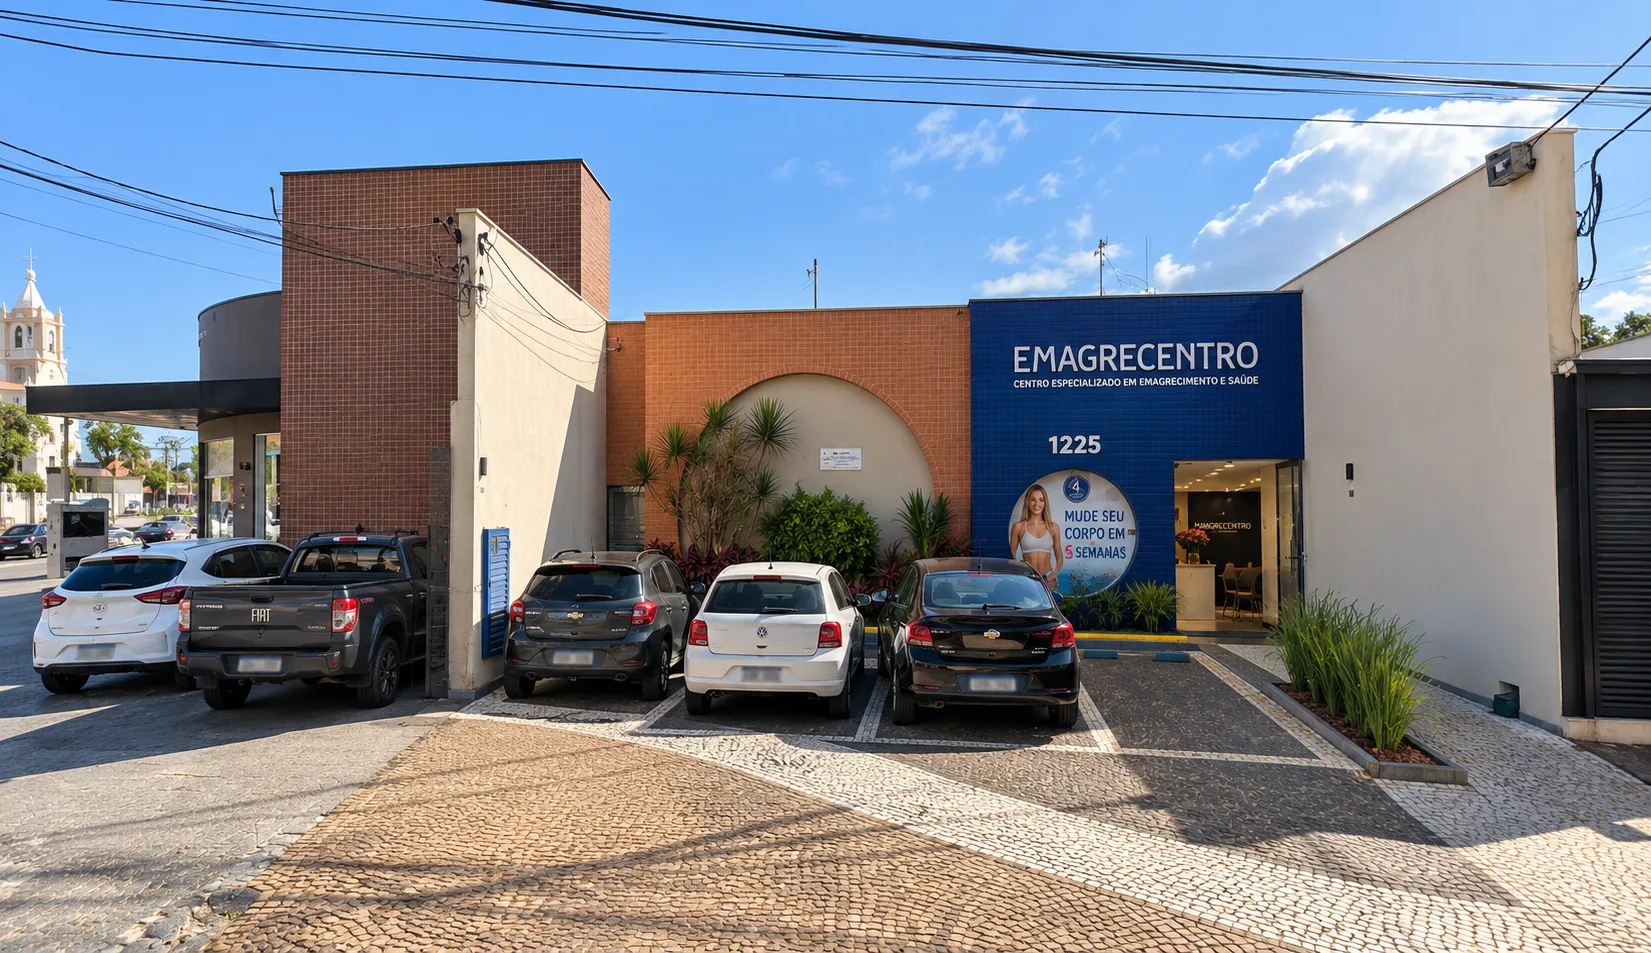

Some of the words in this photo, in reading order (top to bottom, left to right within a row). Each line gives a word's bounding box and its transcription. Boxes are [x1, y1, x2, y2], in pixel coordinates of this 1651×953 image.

[1013, 341, 1259, 373] EMAGRECENTRO
[1013, 379, 1049, 388] CENTRO
[1051, 378, 1121, 388] ESPECIALIZADO
[1123, 377, 1137, 387] EM
[1139, 376, 1219, 387] EMAGRECIMENTO
[1220, 376, 1226, 385] E
[1048, 434, 1102, 454] 1225
[1064, 510, 1099, 522] MUDE
[1102, 510, 1125, 522] SEU
[1064, 527, 1105, 540] CORPO
[1108, 527, 1126, 540] EM
[1075, 545, 1127, 560] SEMANAS
[251, 608, 272, 622] FIAT
